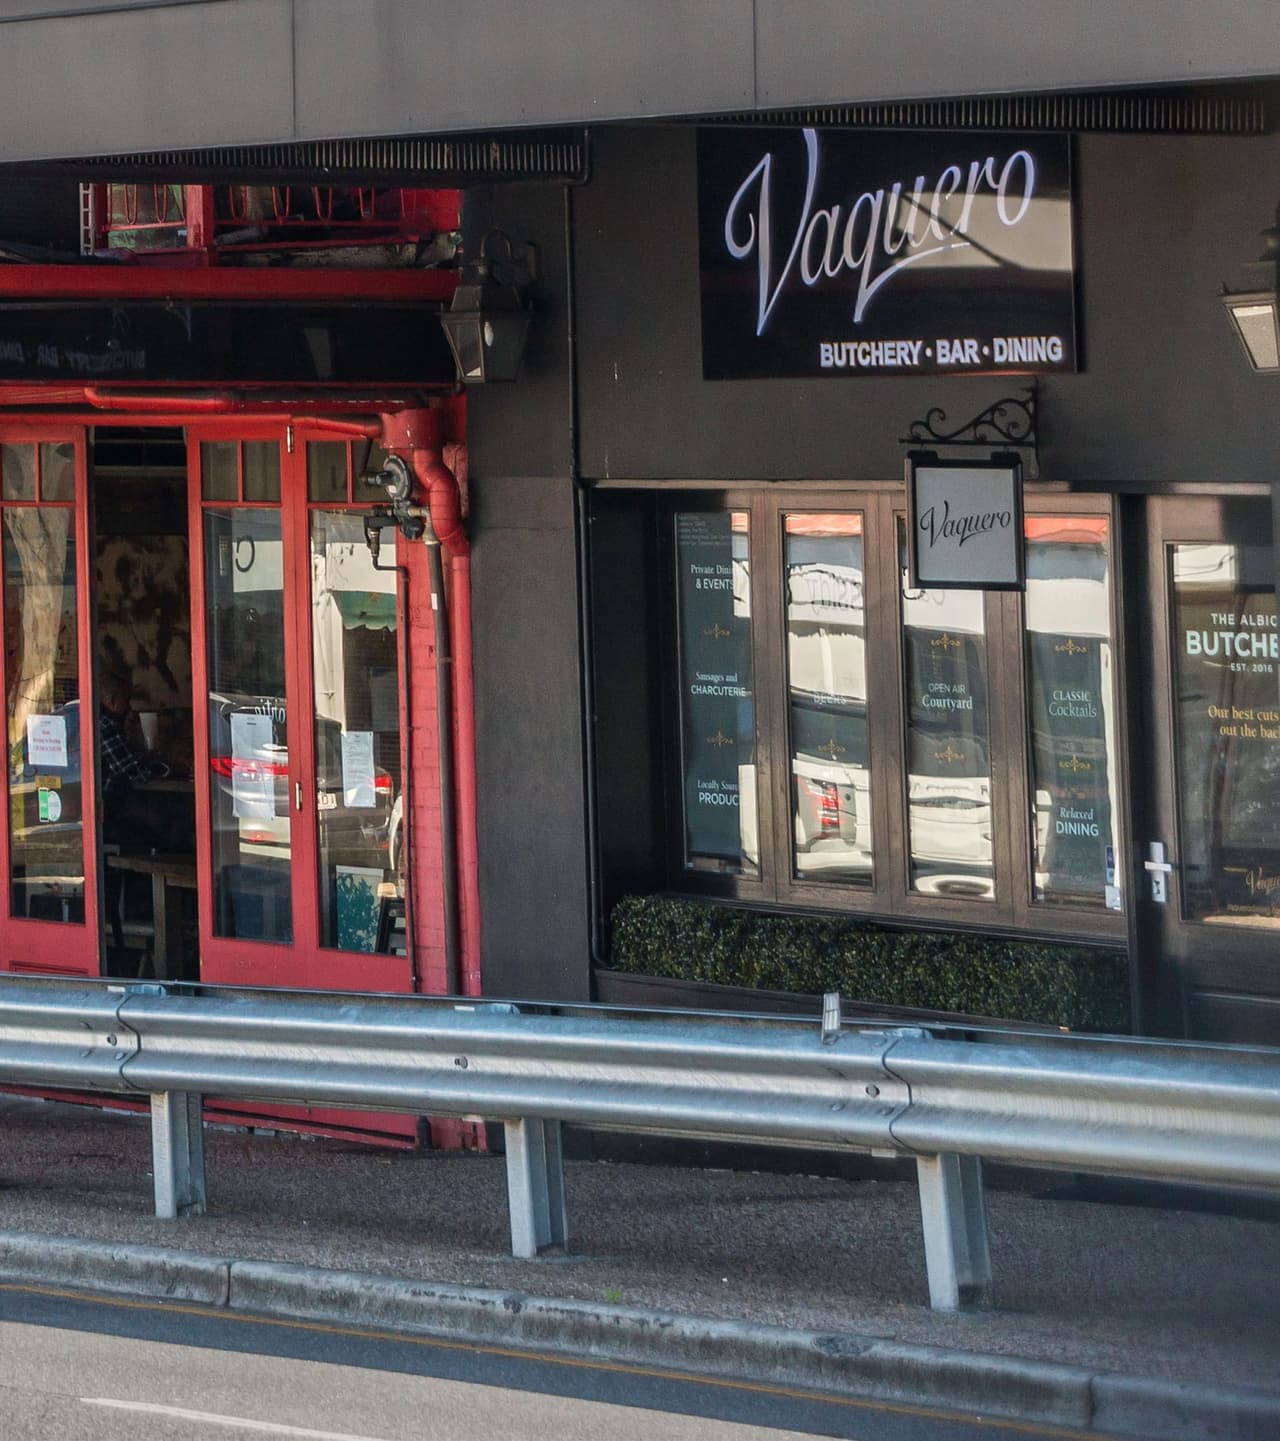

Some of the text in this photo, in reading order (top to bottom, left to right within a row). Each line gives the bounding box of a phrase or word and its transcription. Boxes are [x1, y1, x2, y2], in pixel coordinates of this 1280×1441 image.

[724, 128, 1037, 337] Vaquero
[819, 335, 1063, 368] BUTCHERY BAR DINING
[919, 500, 1011, 548] Vaquero
[1211, 613, 1236, 625] THE
[1252, 663, 1274, 673] 2016
[725, 672, 738, 683] and
[690, 685, 746, 697] CHARCUTERIE
[928, 682, 966, 693] OPEN AIR
[922, 695, 973, 712] Courtyard
[1053, 690, 1090, 702] CLASSIC
[1048, 702, 1097, 718] Cocktails
[1208, 704, 1230, 719] Our
[1231, 705, 1254, 720] best
[1219, 723, 1280, 739] out the bac
[1059, 807, 1094, 820] Relaxed
[1056, 821, 1099, 837] DINING
